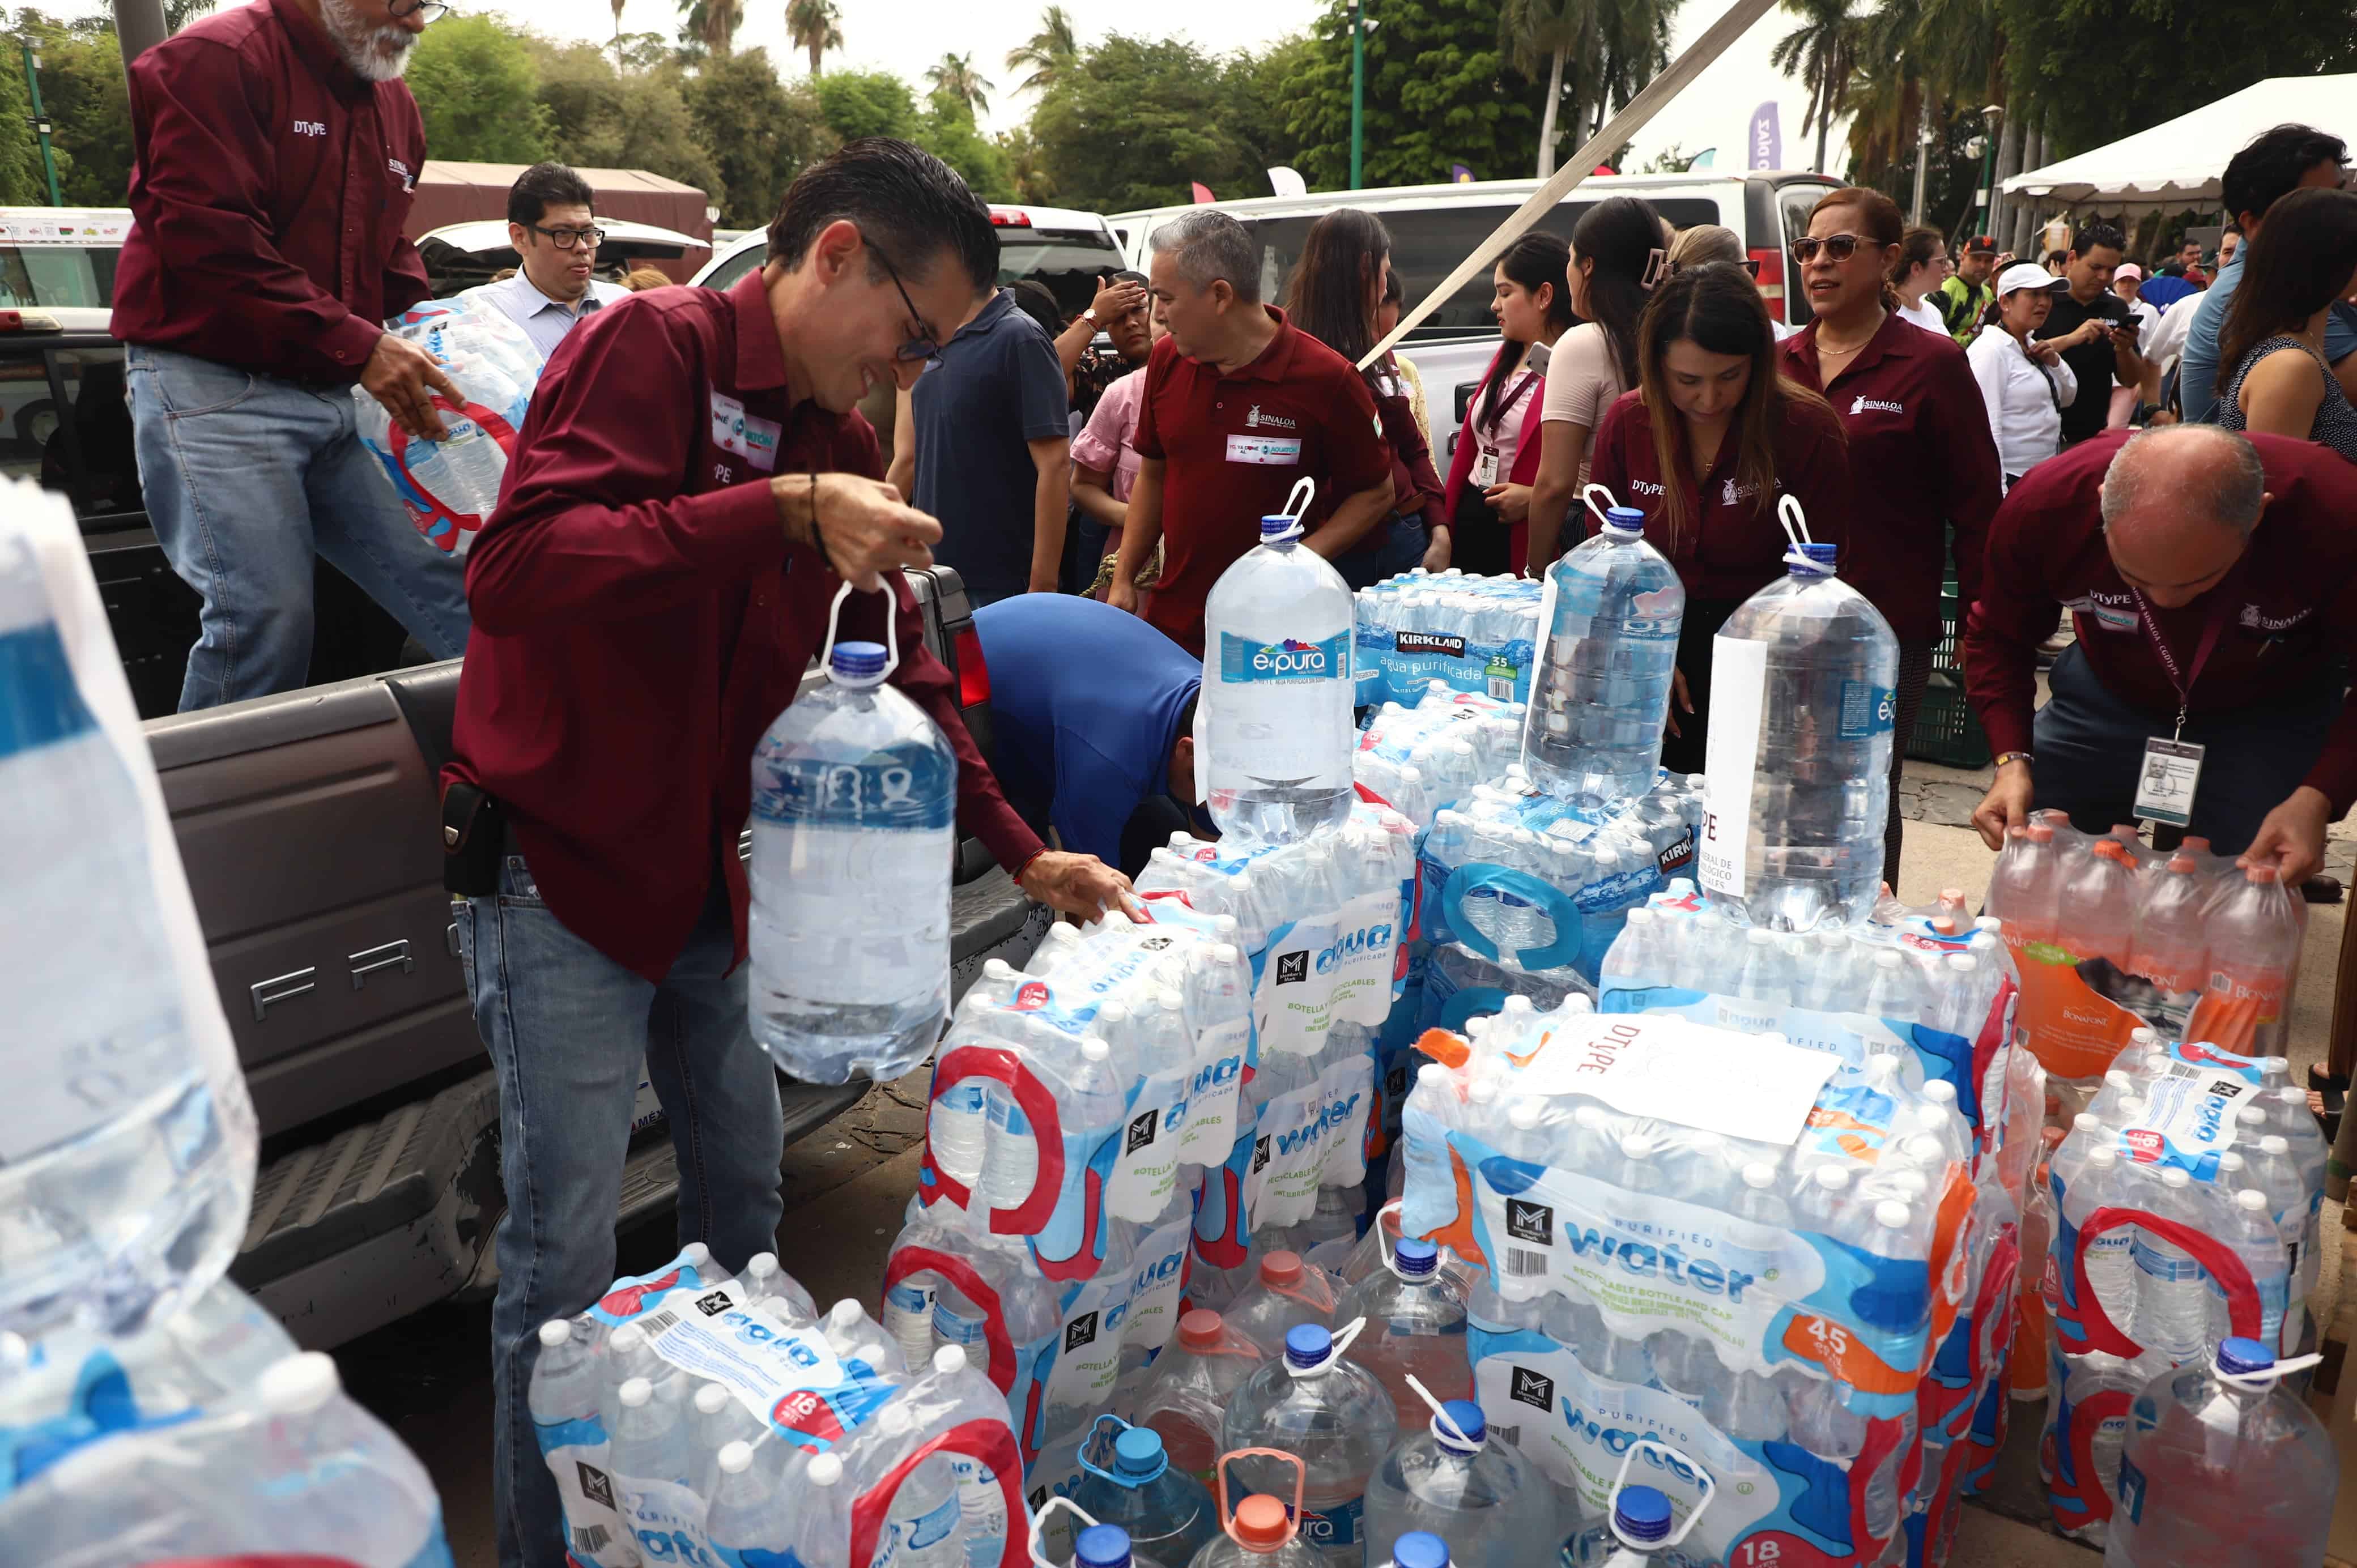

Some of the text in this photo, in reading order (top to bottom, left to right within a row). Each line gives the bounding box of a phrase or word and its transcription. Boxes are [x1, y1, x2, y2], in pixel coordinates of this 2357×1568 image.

[294, 121, 326, 137] DTyPE
[1865, 400, 1902, 410] SINALOA
[1260, 414, 1296, 426] SINALOA
[714, 463, 732, 484] PE
[1632, 479, 1665, 496] DTyPE
[2143, 611, 2160, 642] SINALOA
[1399, 633, 1462, 649] KIRKLAND
[1380, 657, 1407, 673] agua
[1412, 659, 1482, 680] purificada
[1491, 657, 1508, 667] 35
[1720, 859, 1732, 870] DE
[1344, 952, 1387, 966] PURIFICADA
[1287, 1002, 1324, 1014] BOTELLA
[2063, 1010, 2108, 1026] BONAFONT
[1576, 1024, 1641, 1074] DTyPE
[1164, 1055, 1240, 1132] aua
[1134, 1164, 1171, 1176] BOTELLA
[1513, 1225, 1547, 1238] Member's
[1521, 1232, 1539, 1242] Mark
[1614, 1218, 1713, 1249] PURIFIED
[1564, 1221, 1755, 1304] water
[2045, 1259, 2057, 1285] 18
[1105, 1251, 1183, 1331] aua
[1573, 1266, 1733, 1320] RECYCLABLE BOTTLE AND CAP
[1807, 1319, 1847, 1355] 45
[1075, 1358, 1113, 1371] BOTELLA
[792, 1393, 817, 1415] 18
[1599, 1408, 1688, 1442] PURIFIED
[1550, 1434, 1605, 1488] RECYCLABLE
[1742, 1540, 1781, 1566] 18
